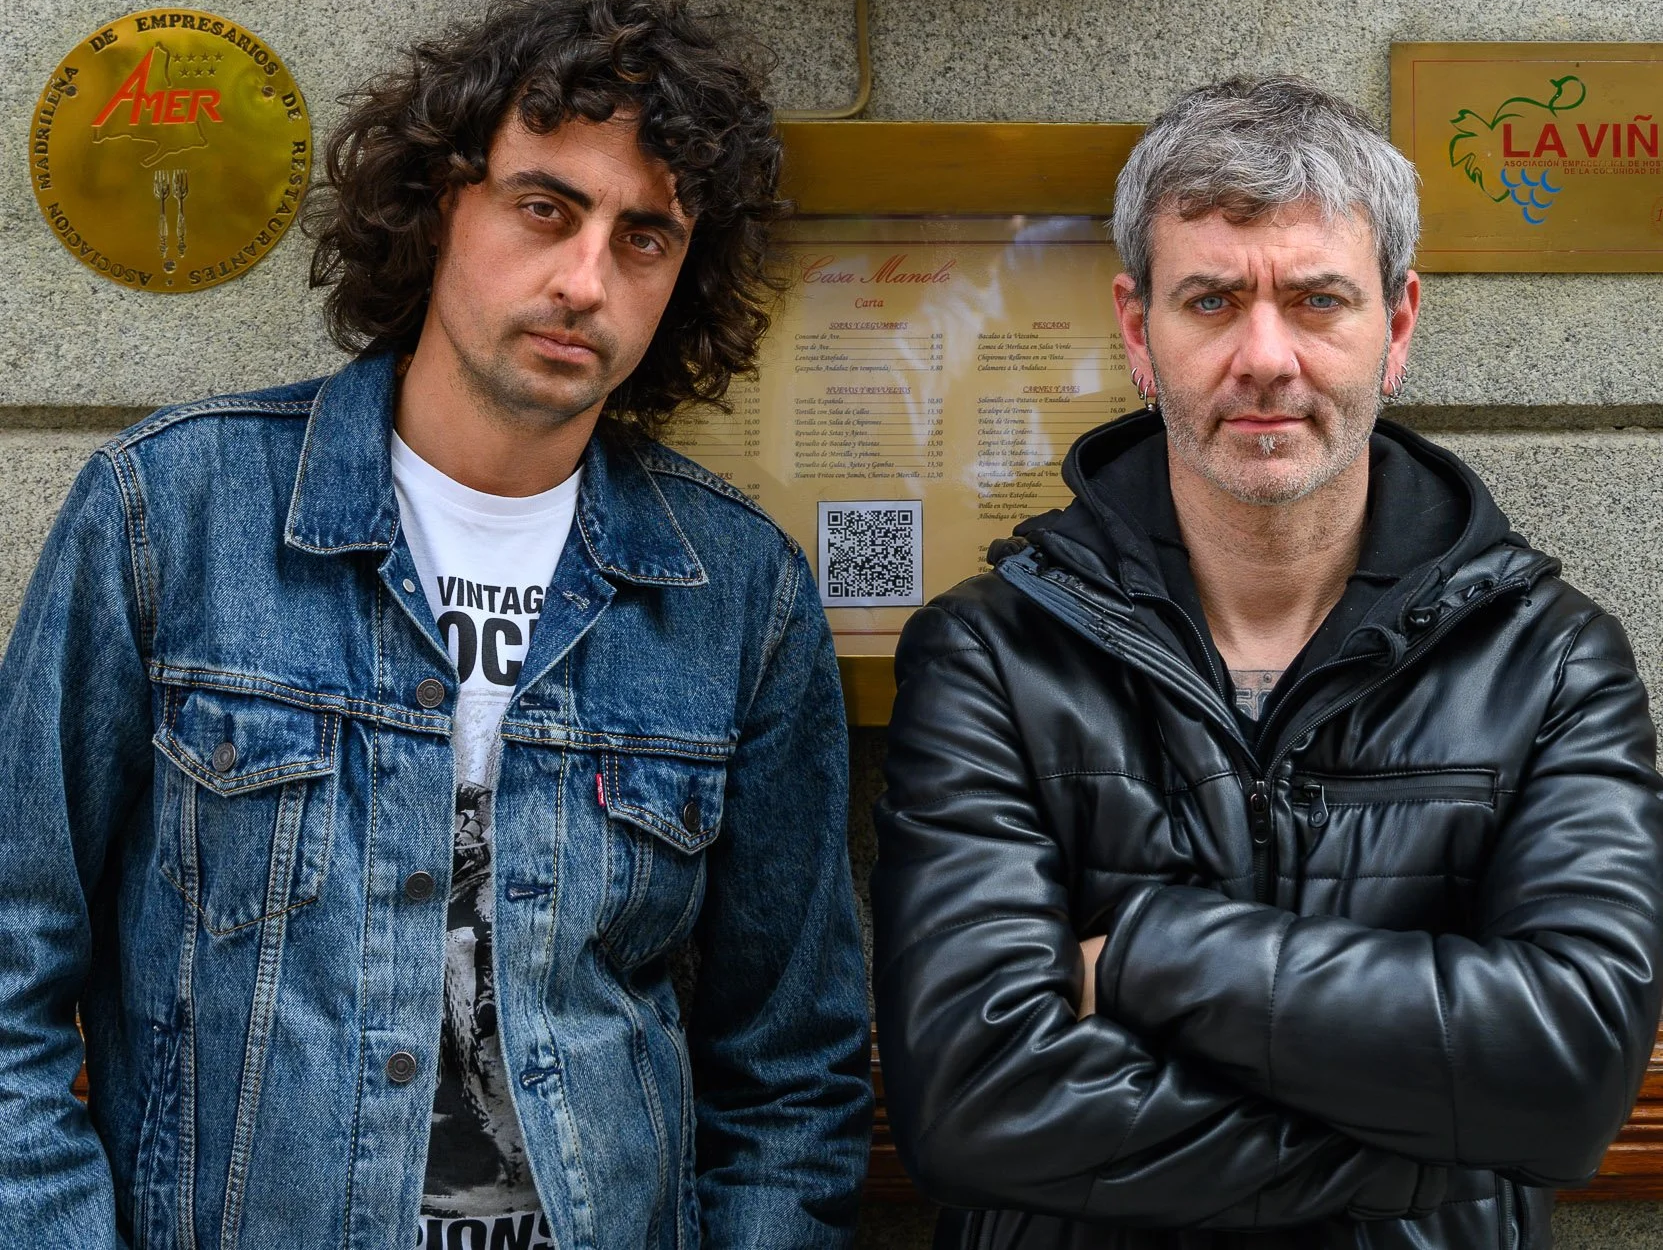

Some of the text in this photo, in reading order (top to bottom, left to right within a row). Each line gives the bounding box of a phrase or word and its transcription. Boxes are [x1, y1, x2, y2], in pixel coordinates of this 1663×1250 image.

[89, 28, 118, 53] DE
[135, 13, 279, 77] EMPRESARIOS
[281, 91, 303, 123] DE
[1503, 114, 1663, 158] LA VIÑ
[1504, 158, 1559, 167] ASOCIACIÓN
[188, 139, 308, 286] RESTAURANTES
[800, 254, 957, 284] Casa Manolo
[854, 298, 885, 309] Carta
[437, 576, 549, 615] VINTAG
[436, 610, 540, 687] OC
